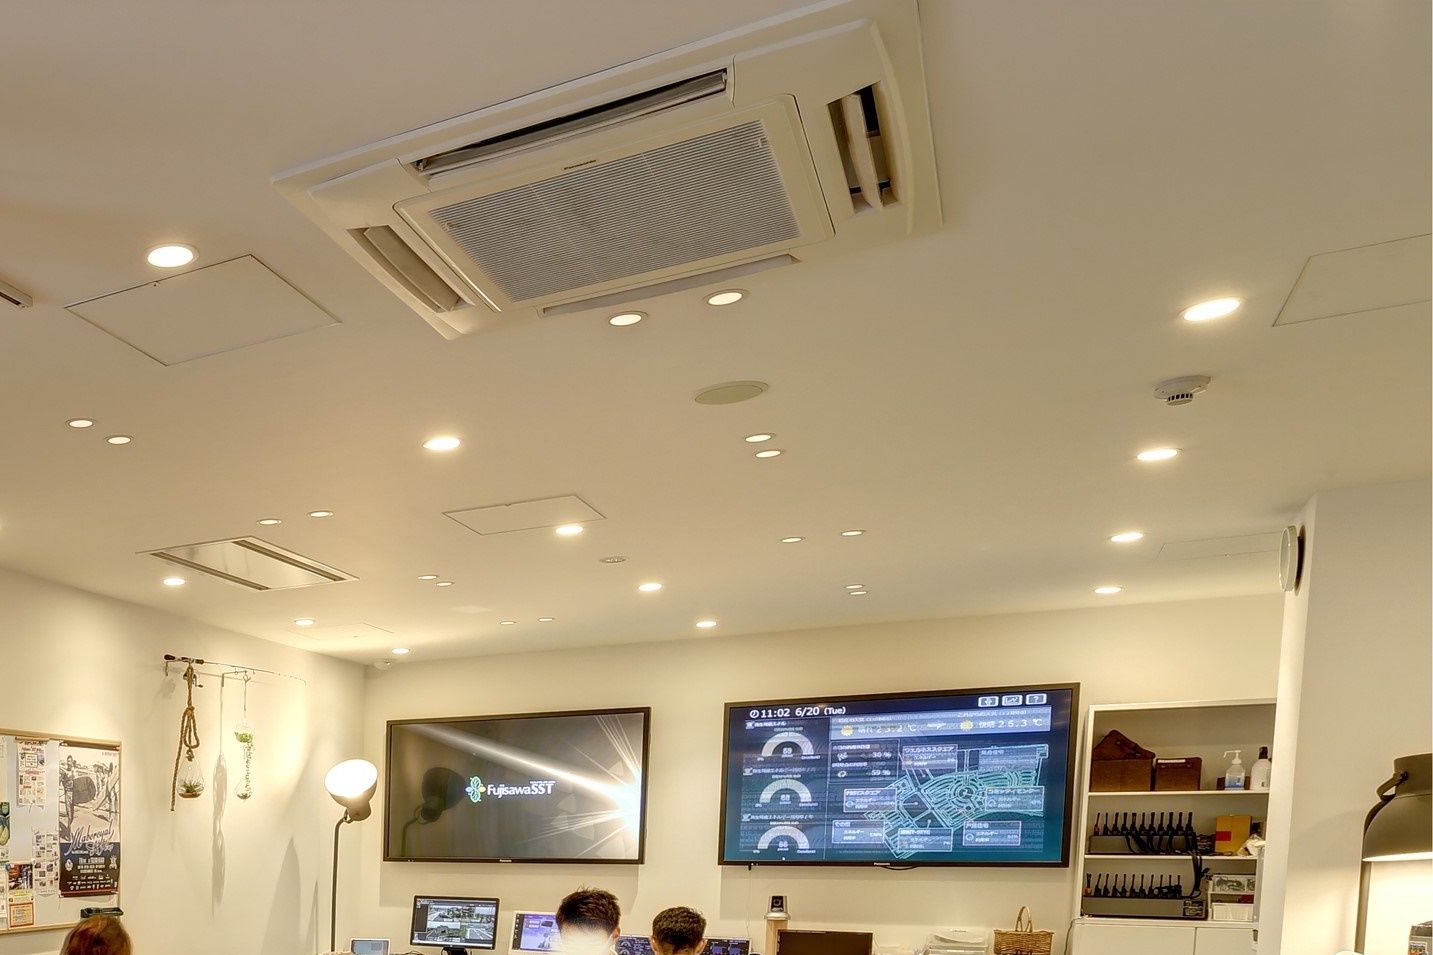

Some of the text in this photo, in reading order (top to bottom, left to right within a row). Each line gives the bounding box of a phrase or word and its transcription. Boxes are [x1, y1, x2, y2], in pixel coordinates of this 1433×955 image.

[761, 707, 847, 718] 11:02 6/20 (Tue)
